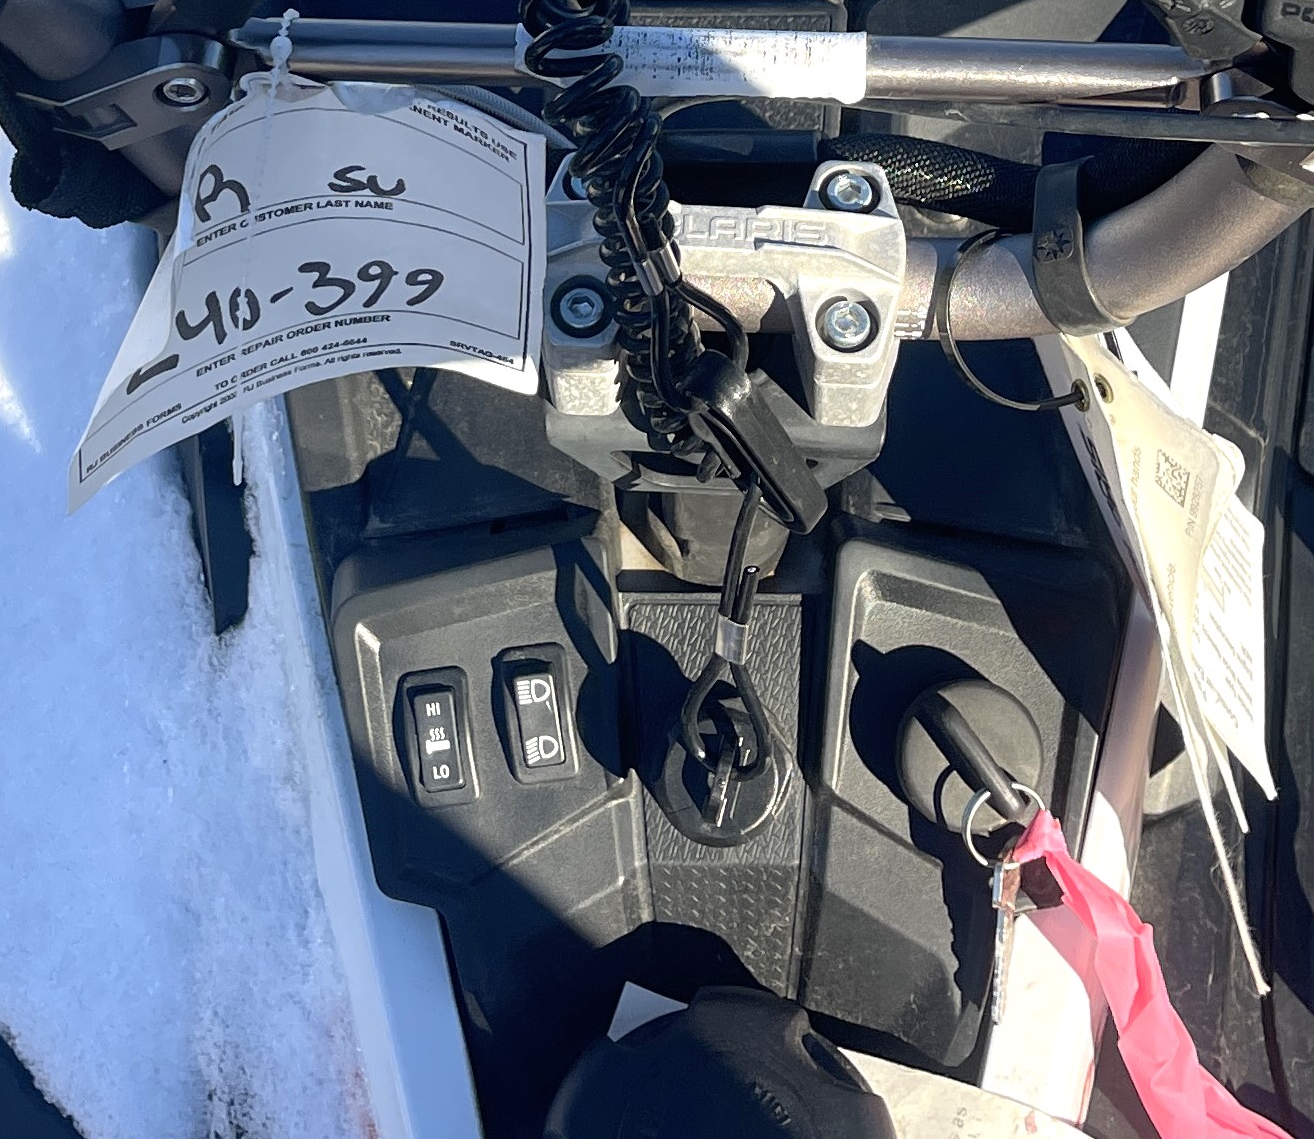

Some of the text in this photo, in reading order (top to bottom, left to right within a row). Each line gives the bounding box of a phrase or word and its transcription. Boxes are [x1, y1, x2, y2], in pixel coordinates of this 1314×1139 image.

[196, 200, 394, 247] ENTER CSTOMER LAST NAME
[196, 314, 391, 378] ENTER REPAIR ORDER NUMBER
[215, 379, 229, 391] TO
[270, 353, 298, 370] CALL
[425, 702, 441, 717] HI
[432, 765, 450, 780] LO
